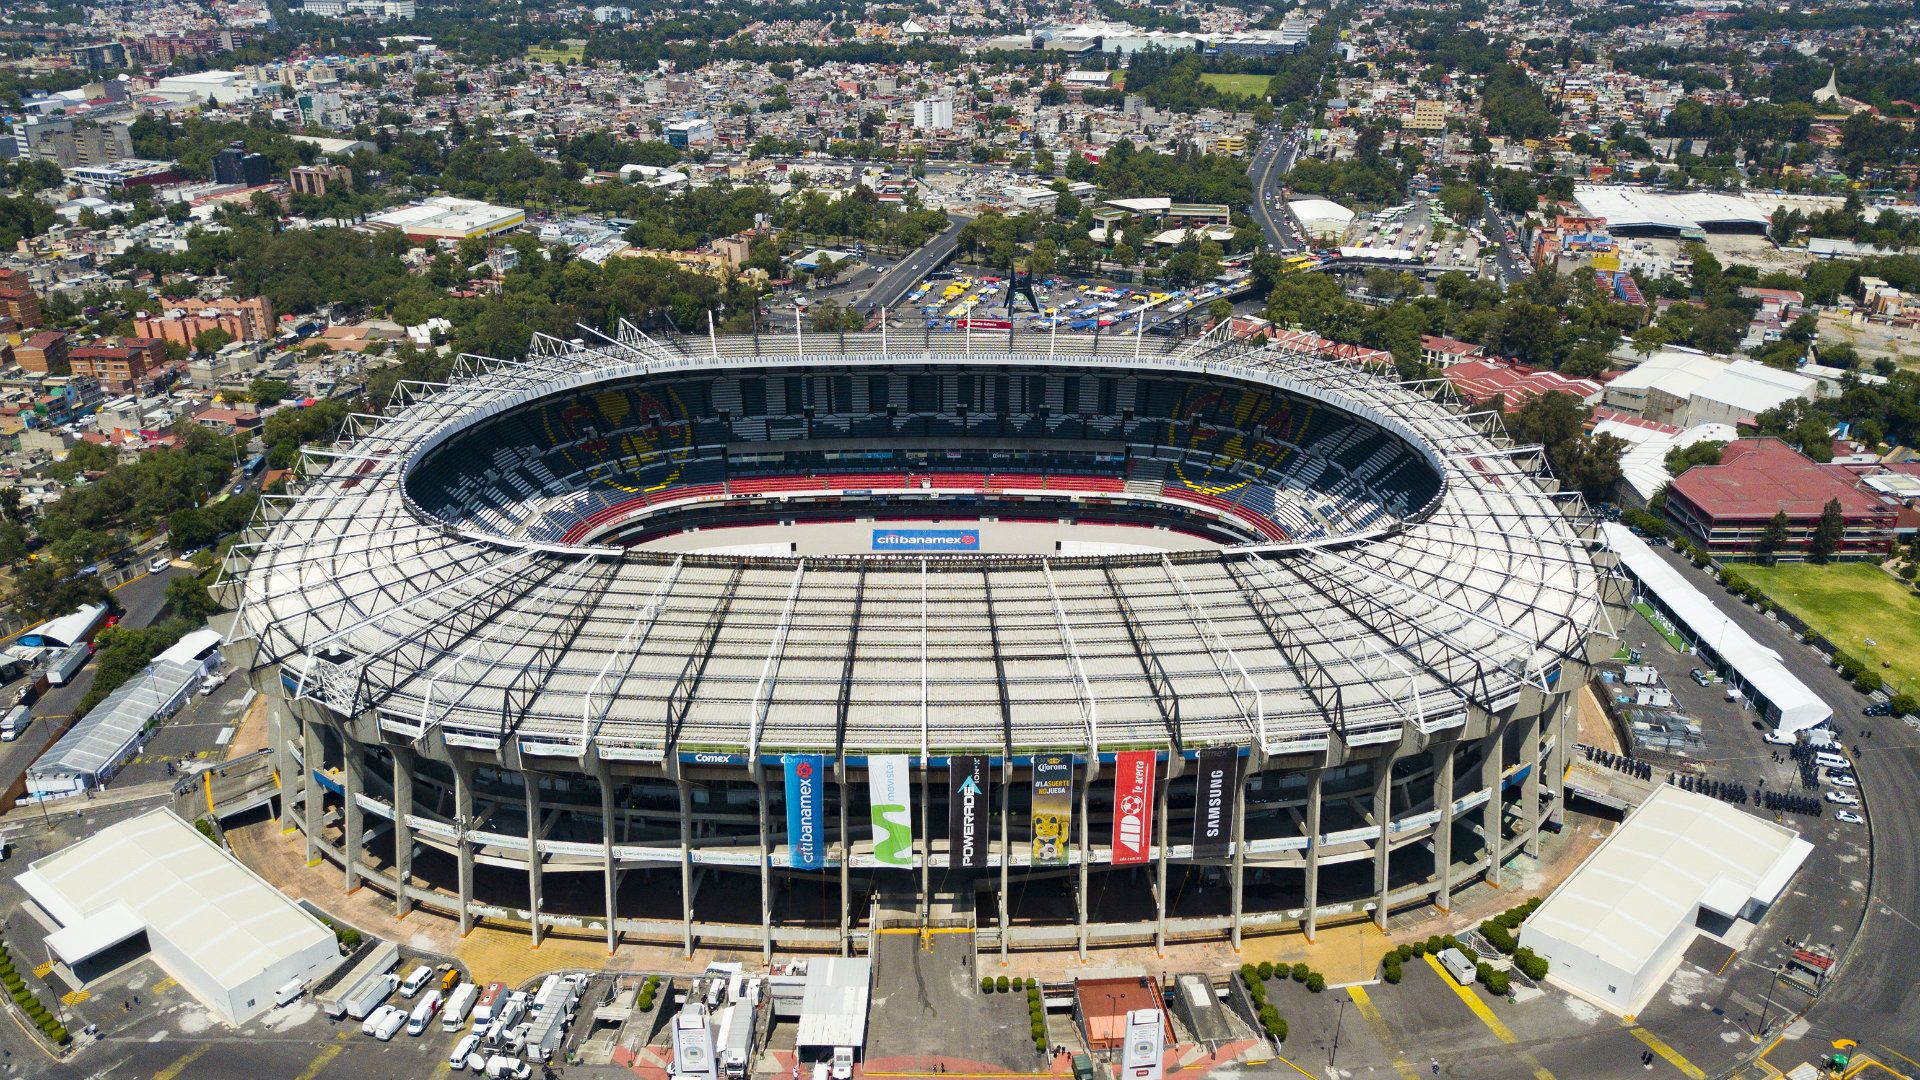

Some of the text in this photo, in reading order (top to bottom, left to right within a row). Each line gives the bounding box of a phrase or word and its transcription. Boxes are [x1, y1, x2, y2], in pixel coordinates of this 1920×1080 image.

[877, 534, 961, 544] citibanamex
[695, 754, 732, 763] Comex
[1038, 763, 1068, 772] Corona
[1135, 760, 1144, 784] acerca
[886, 762, 895, 801] movistar
[1206, 769, 1224, 838] SAMSUNG
[800, 778, 814, 863] citibanamex
[962, 784, 975, 867] POWERADE
